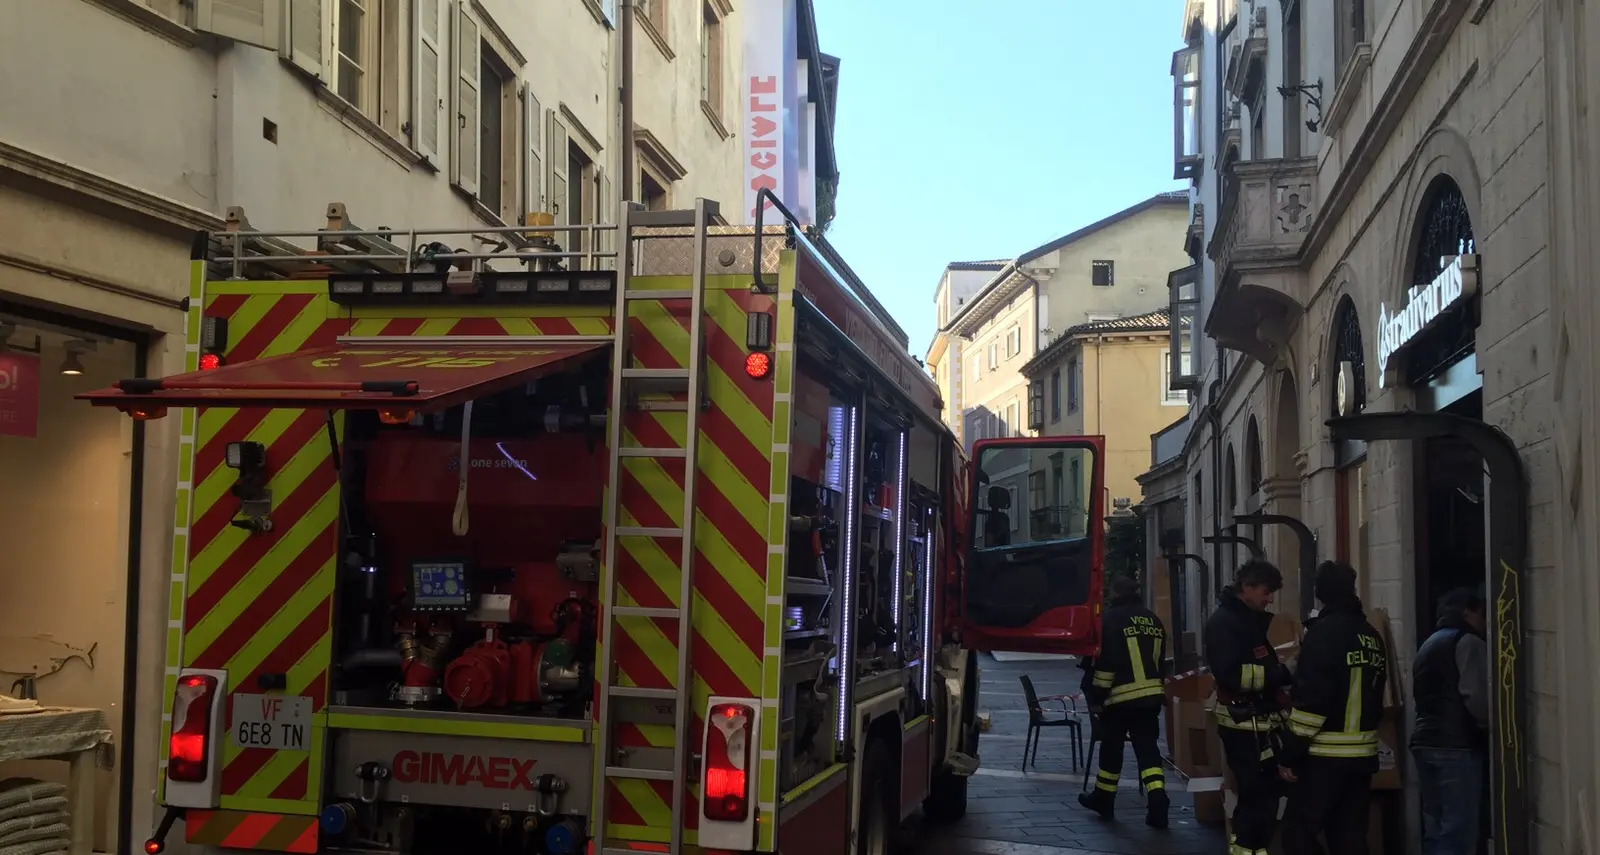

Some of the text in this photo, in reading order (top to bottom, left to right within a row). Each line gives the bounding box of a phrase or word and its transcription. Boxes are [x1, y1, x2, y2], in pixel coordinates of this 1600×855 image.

[471, 459, 527, 468] one seven
[1346, 650, 1369, 666] DEL
[262, 698, 282, 721] VF
[239, 721, 303, 746] 6E8 TN
[392, 750, 538, 791] GIMAEX
